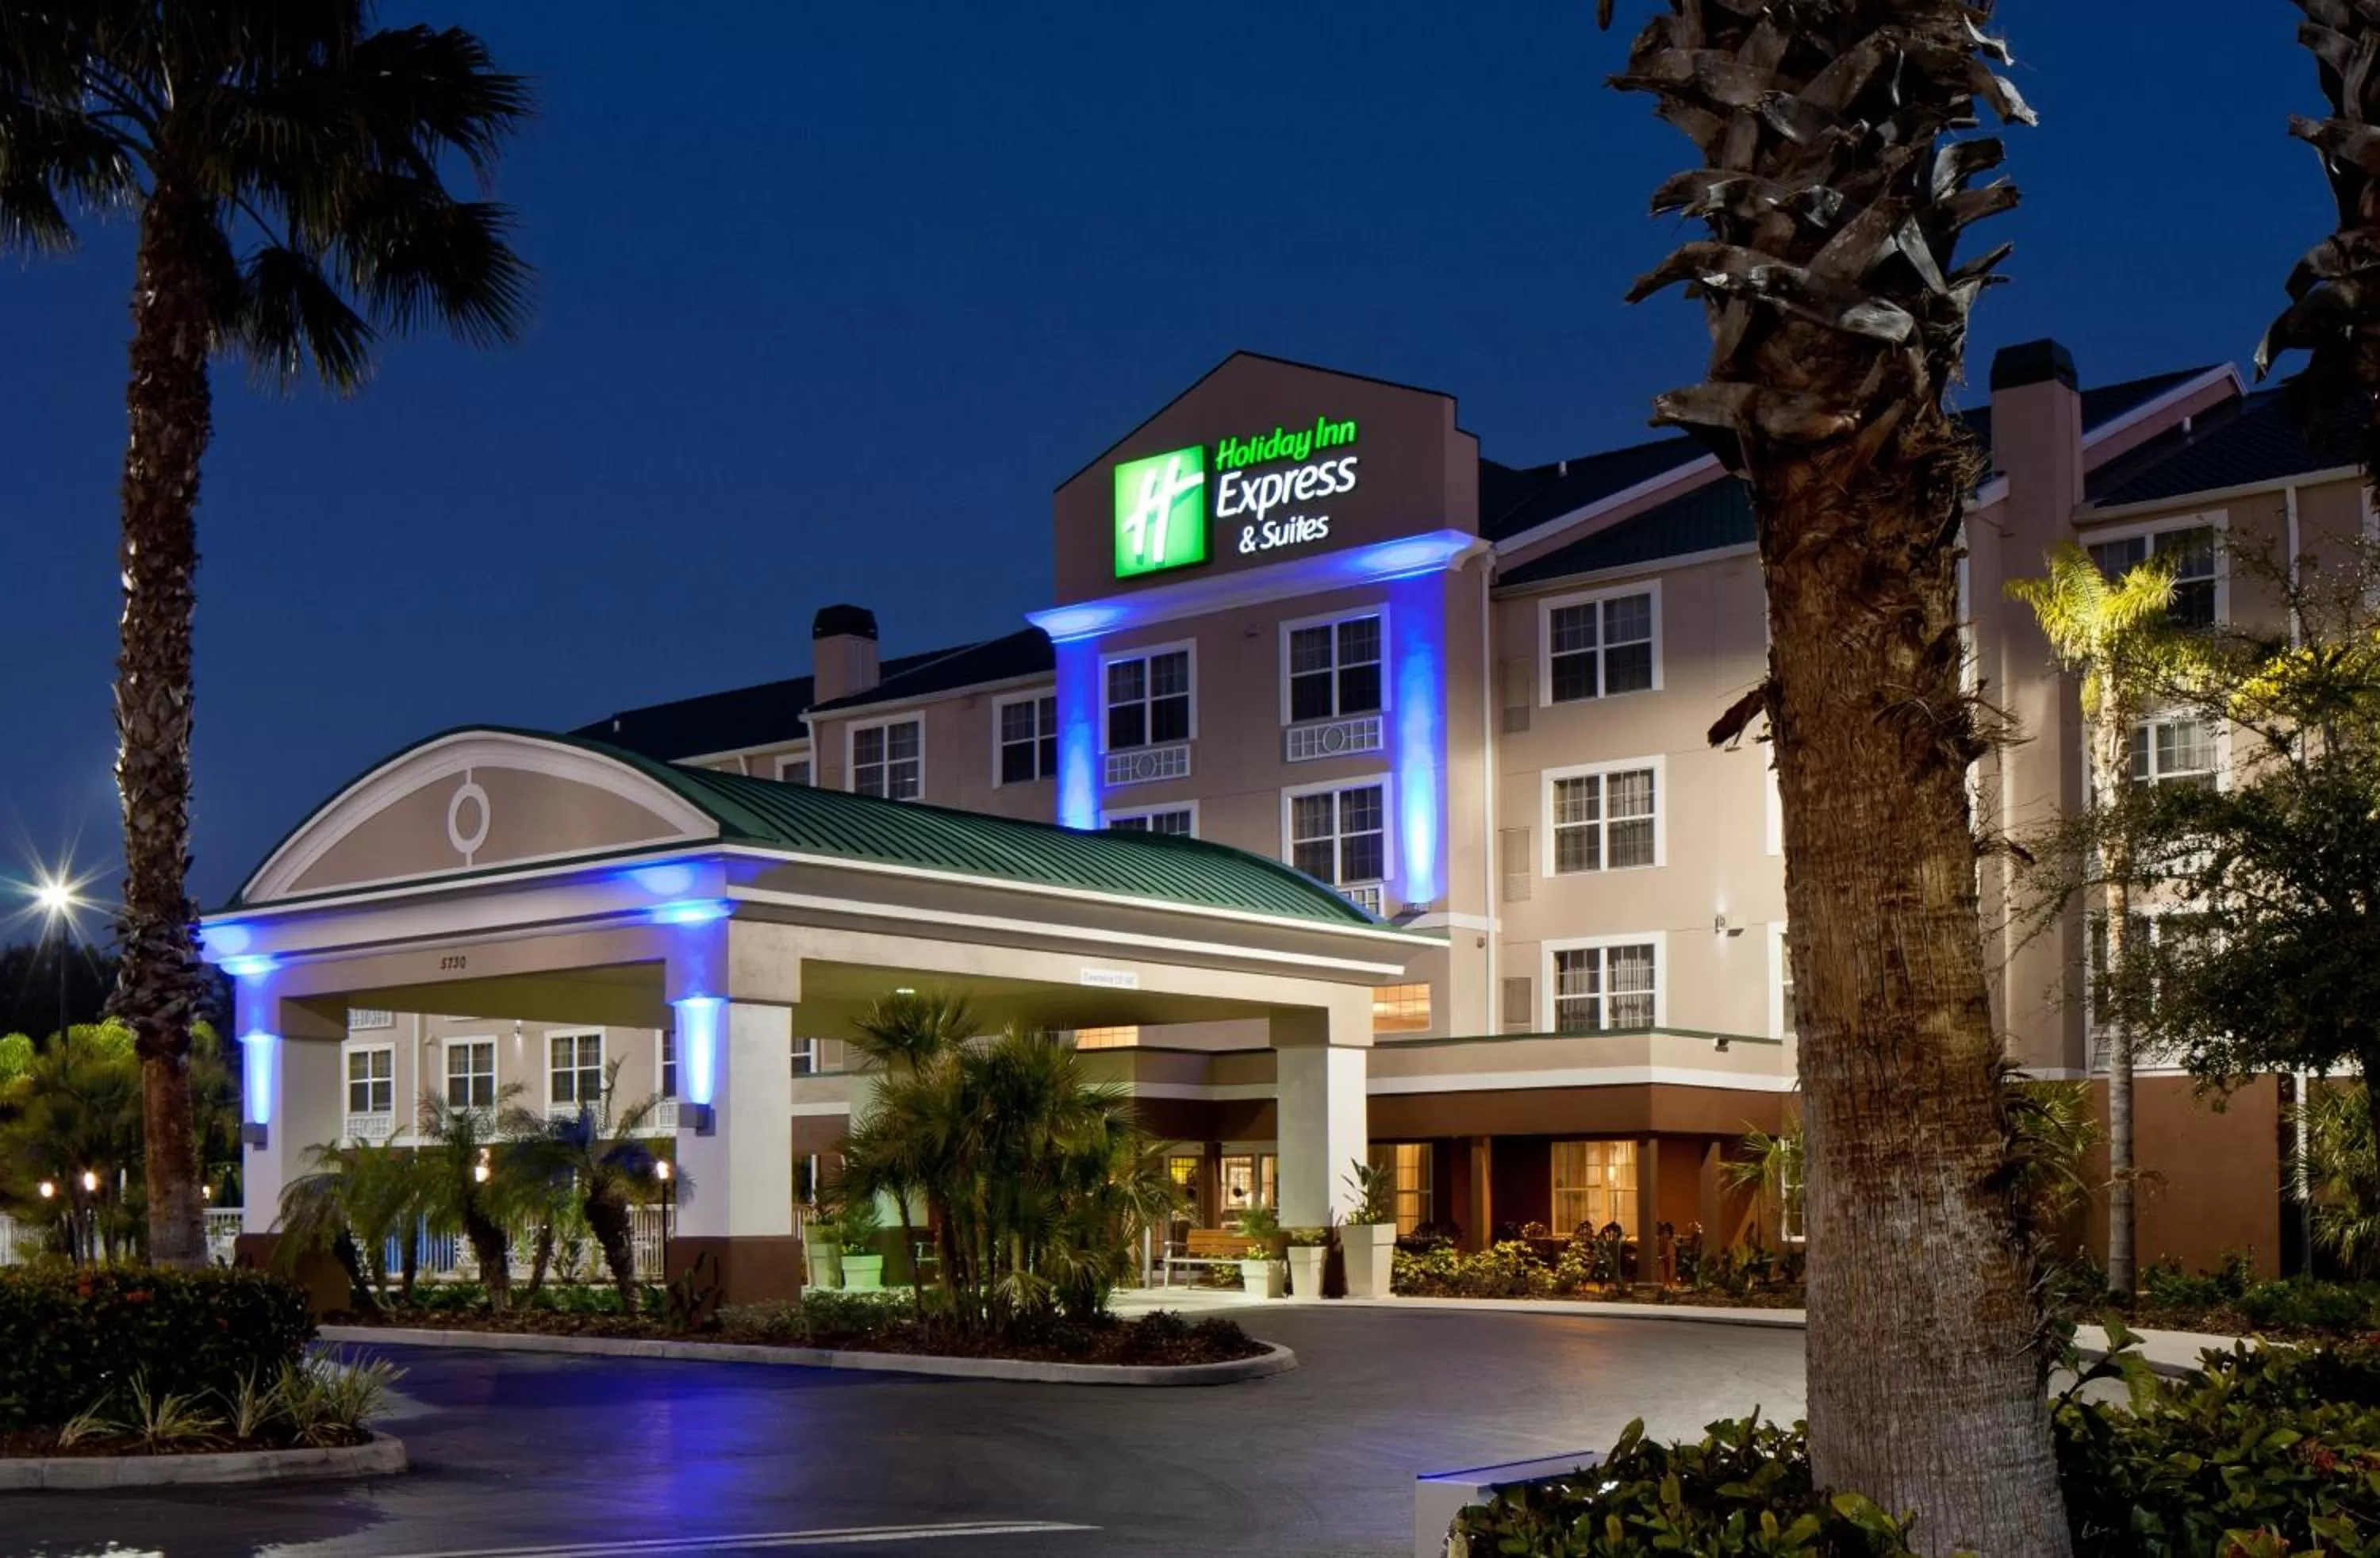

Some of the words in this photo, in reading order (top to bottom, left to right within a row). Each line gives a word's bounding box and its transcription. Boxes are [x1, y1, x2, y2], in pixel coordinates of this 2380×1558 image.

[1215, 428, 1312, 470] Holiday
[1315, 416, 1357, 449] Inn
[1216, 456, 1357, 520] Express
[1238, 526, 1257, 554] &
[1260, 516, 1330, 549] Suites
[440, 955, 466, 970] 5730
